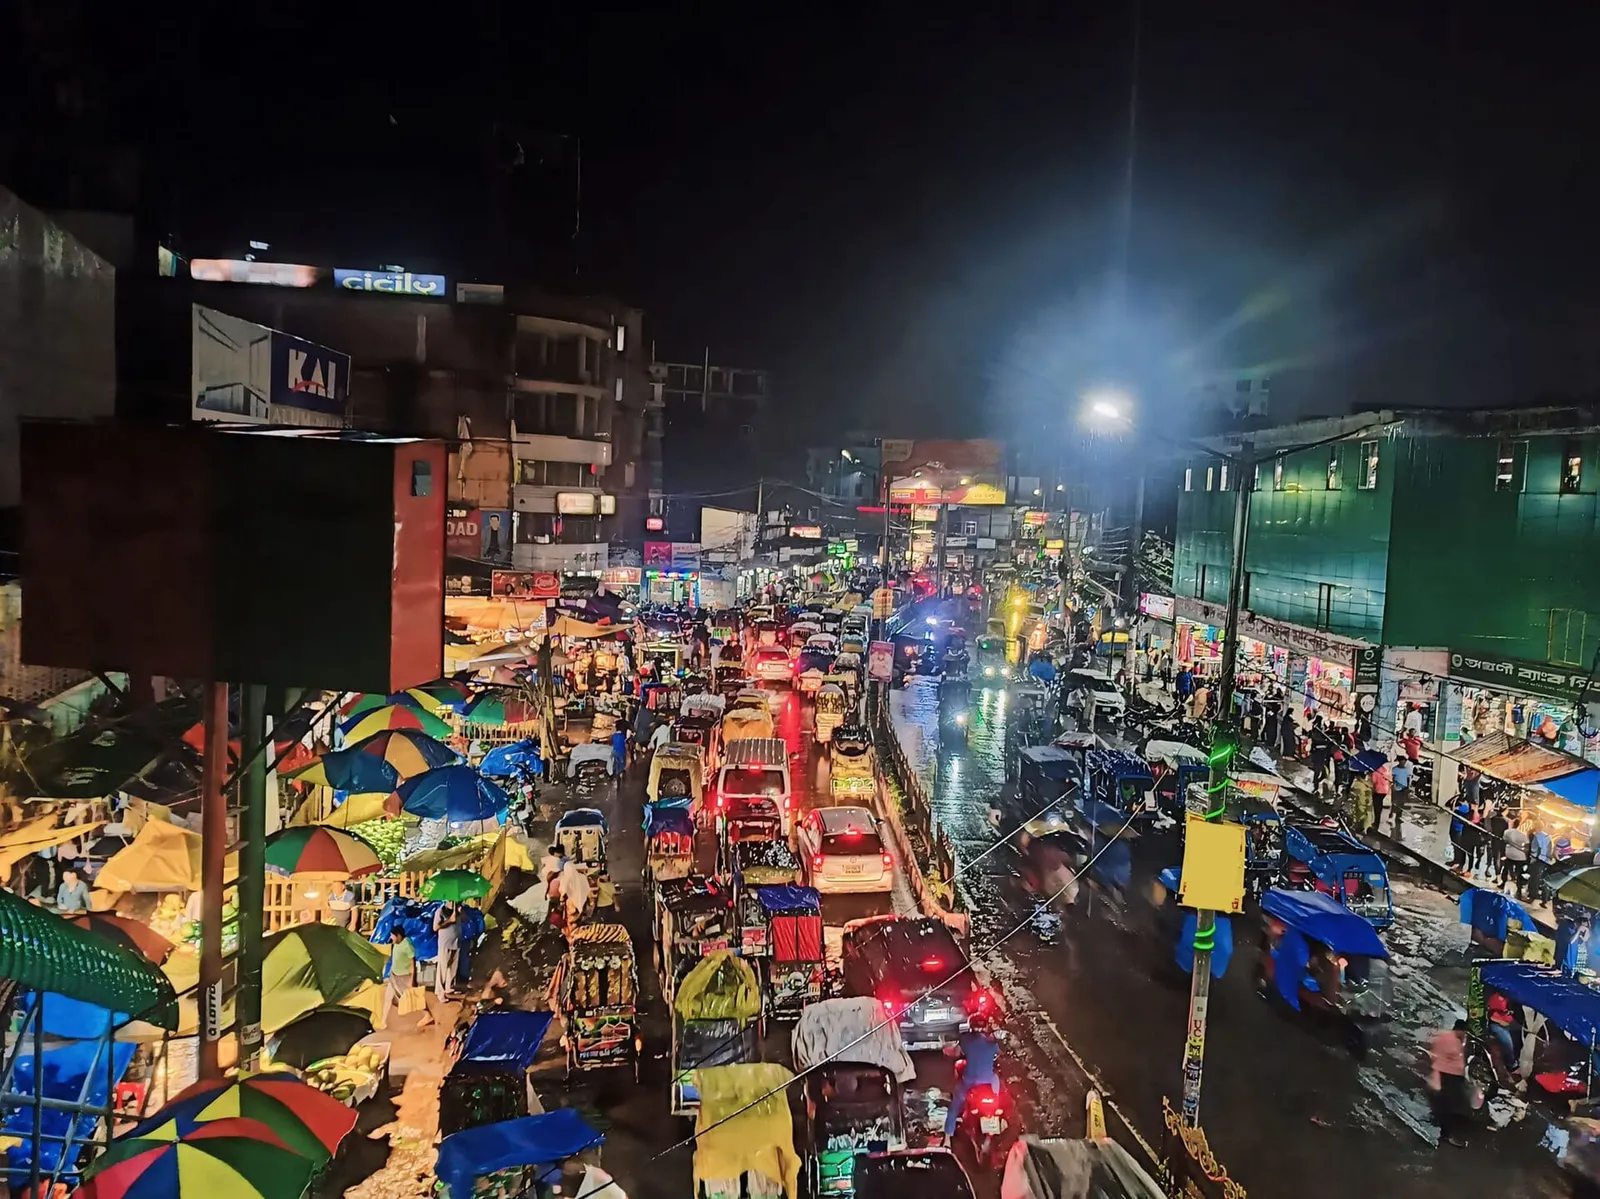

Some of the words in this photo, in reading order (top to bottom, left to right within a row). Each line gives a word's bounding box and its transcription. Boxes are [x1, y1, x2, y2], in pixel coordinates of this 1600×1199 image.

[342, 272, 437, 295] cicily
[288, 348, 336, 399] KAI
[209, 984, 217, 1025] LOTTO
